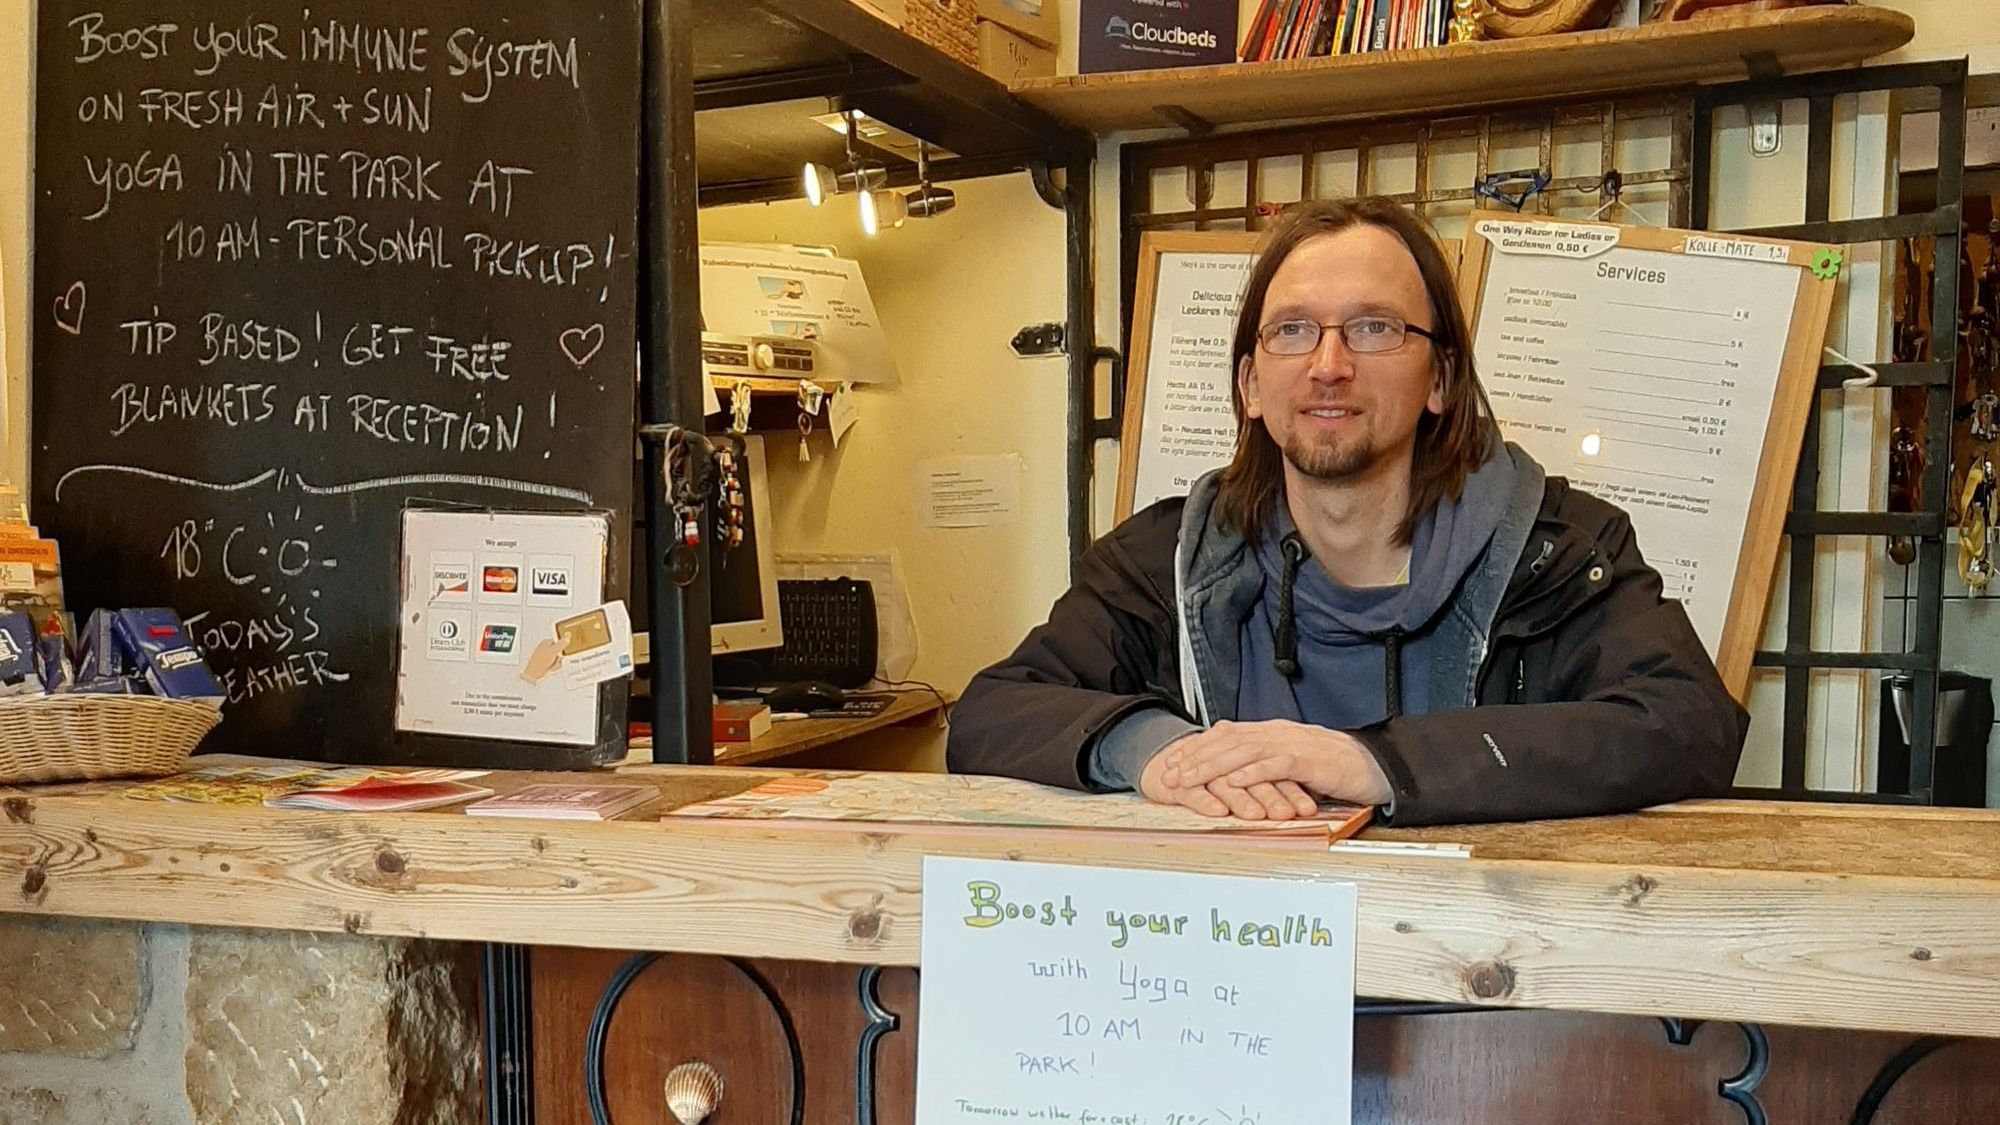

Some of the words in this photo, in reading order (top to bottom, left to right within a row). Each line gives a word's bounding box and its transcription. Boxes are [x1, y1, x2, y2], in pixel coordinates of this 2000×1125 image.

[1131, 21, 1217, 48] Cloudbeds
[1374, 18, 1386, 50] Berlin
[78, 90, 124, 122] ON
[138, 86, 243, 129] FRESH
[256, 82, 325, 129] AIR
[363, 87, 433, 133] SUN
[81, 150, 184, 220] YOGA
[218, 142, 252, 196] IN
[271, 151, 330, 196] THE
[338, 151, 443, 202] PARK
[468, 159, 535, 218] AT
[167, 218, 206, 259] 10
[287, 217, 453, 270] PERSONAL
[1483, 224, 1500, 233] One
[1503, 226, 1522, 236] Way
[1525, 227, 1552, 237] Razor
[1555, 229, 1569, 238] for
[1571, 230, 1602, 241] Ladies
[1597, 262, 1666, 284] Services
[1182, 306, 1220, 316] Leckeres
[1192, 291, 1232, 302] Delicious
[119, 304, 177, 355] TIP
[342, 322, 414, 366] GET
[426, 334, 513, 381] FREE
[110, 382, 277, 437] BLANKETS
[294, 395, 332, 432] AT
[537, 572, 567, 586] VISA
[155, 646, 203, 670] Tempo
[222, 650, 351, 703] EATHER
[963, 880, 1077, 928] Boost
[1106, 909, 1189, 948] your
[1211, 908, 1333, 948] health
[1028, 959, 1088, 980] with
[1118, 959, 1189, 1002] Yoga
[1214, 984, 1240, 1006] at
[1056, 1012, 1091, 1037] 10
[1103, 1018, 1141, 1041] AM
[1180, 1017, 1203, 1045] IN
[1228, 1031, 1272, 1057] THE
[955, 1098, 1019, 1117] Tomorrow
